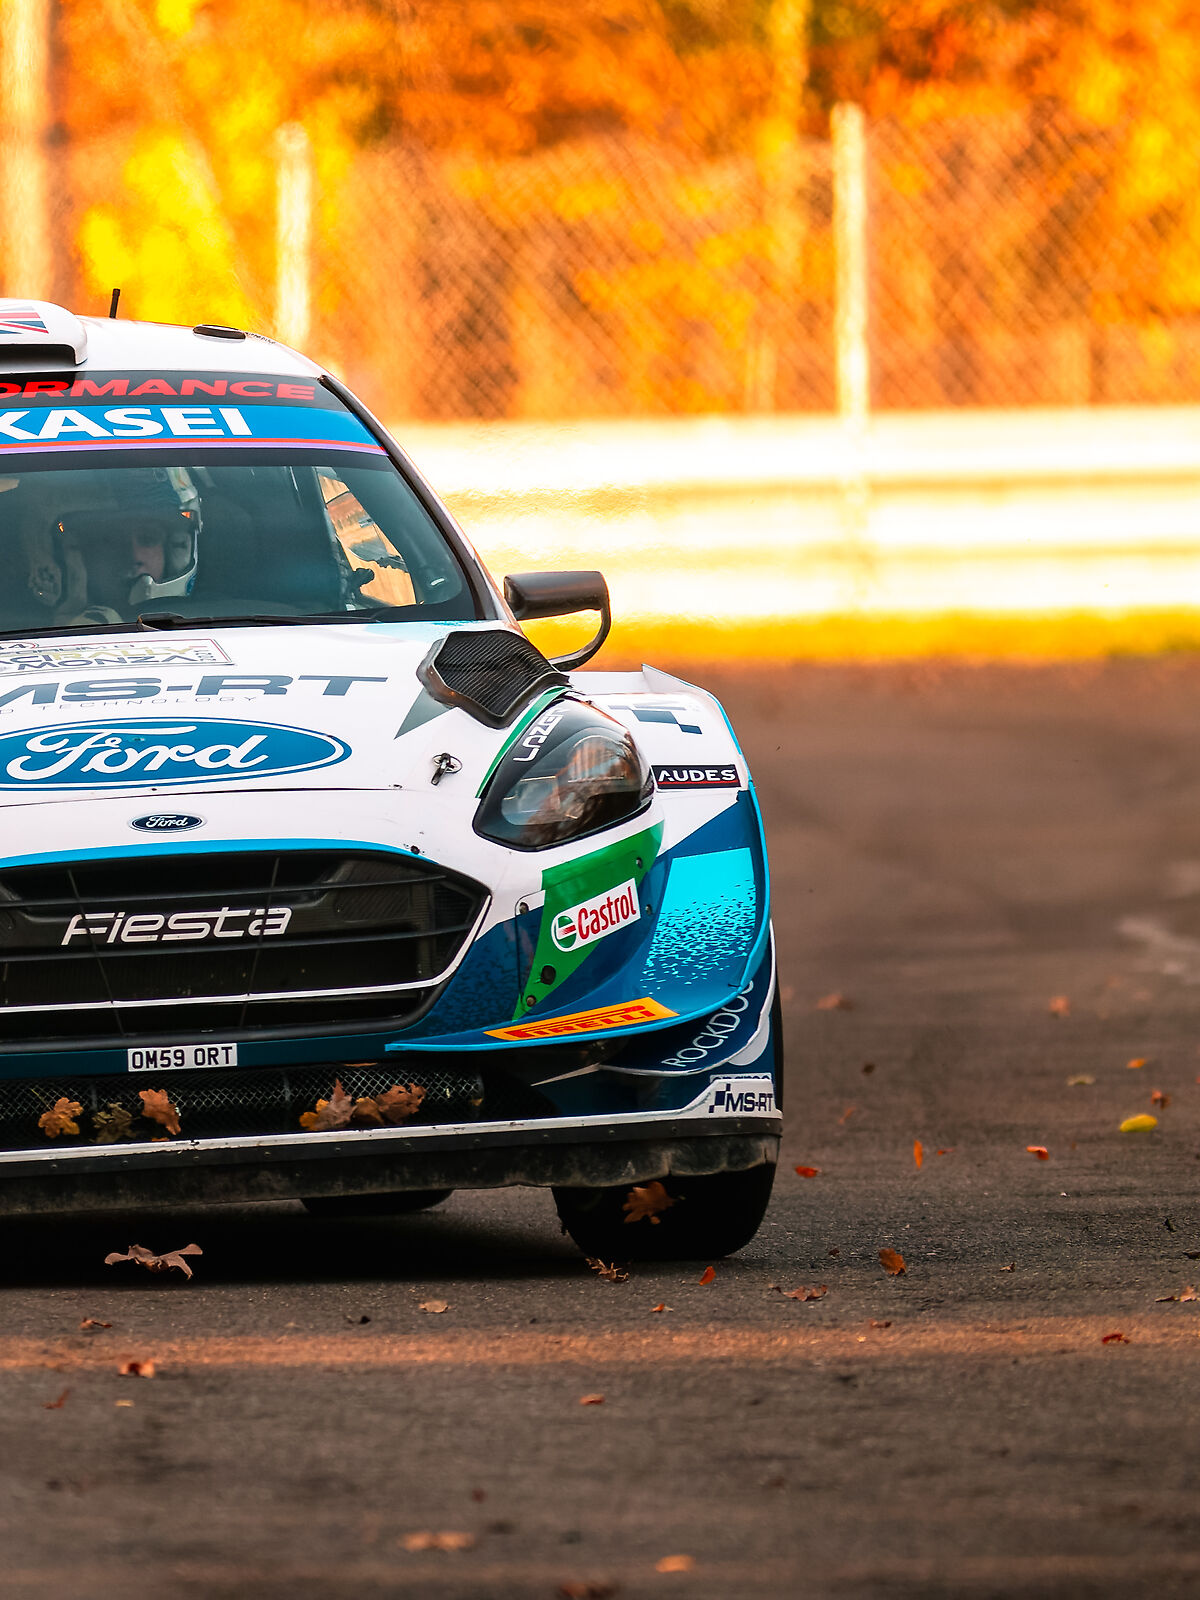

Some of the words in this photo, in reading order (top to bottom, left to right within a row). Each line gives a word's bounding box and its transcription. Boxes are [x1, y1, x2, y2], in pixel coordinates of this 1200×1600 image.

[17, 655, 200, 671] MONZA
[41, 696, 258, 711] TECHNOLOGY
[6, 726, 270, 781] Ford
[658, 768, 737, 782] AUDES
[145, 814, 188, 828] Ford
[576, 886, 637, 940] Castrol
[62, 906, 293, 946] Fiesta
[503, 1006, 657, 1038] PIRELLI
[132, 1049, 185, 1069] OM59
[194, 1046, 232, 1066] ORT
[725, 1091, 773, 1113] MS-RT
